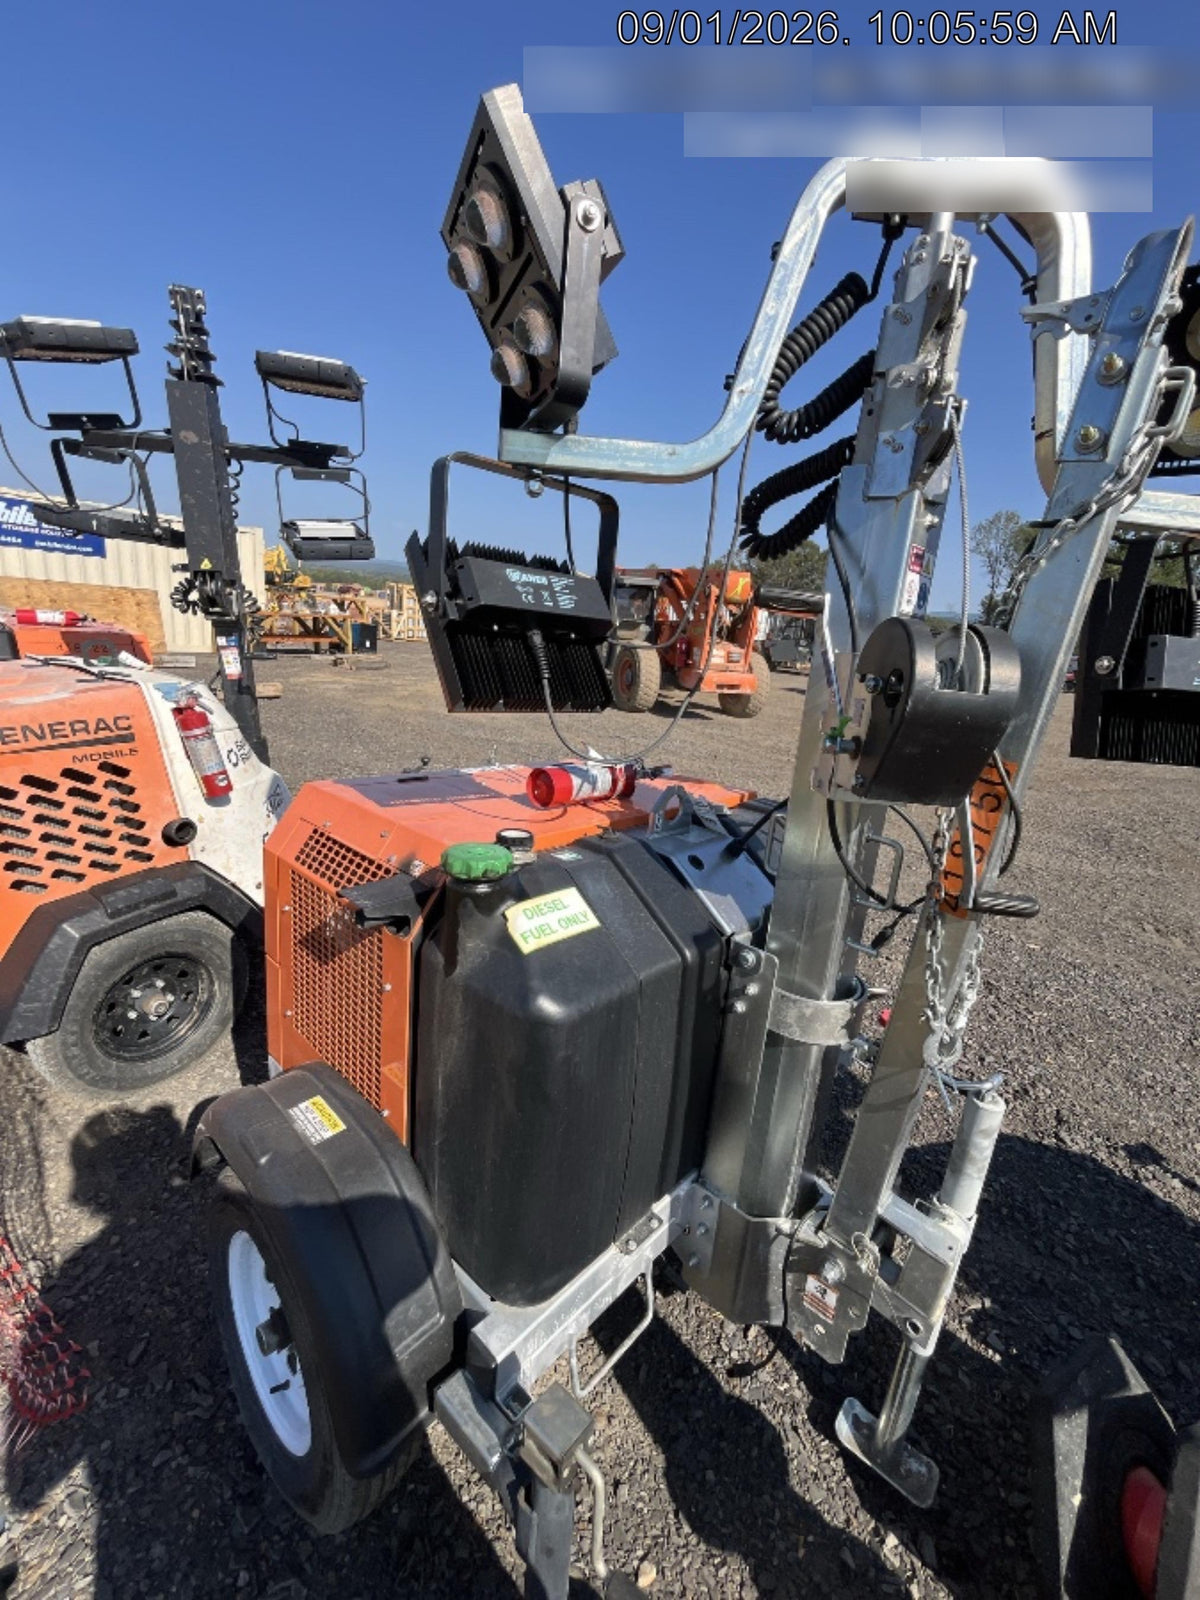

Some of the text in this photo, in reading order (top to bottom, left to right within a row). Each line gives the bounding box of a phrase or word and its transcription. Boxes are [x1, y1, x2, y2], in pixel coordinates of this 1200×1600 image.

[72, 747, 139, 764] MOBILE
[522, 898, 569, 920] DIESEL
[520, 910, 590, 944] FUEL ONLY
